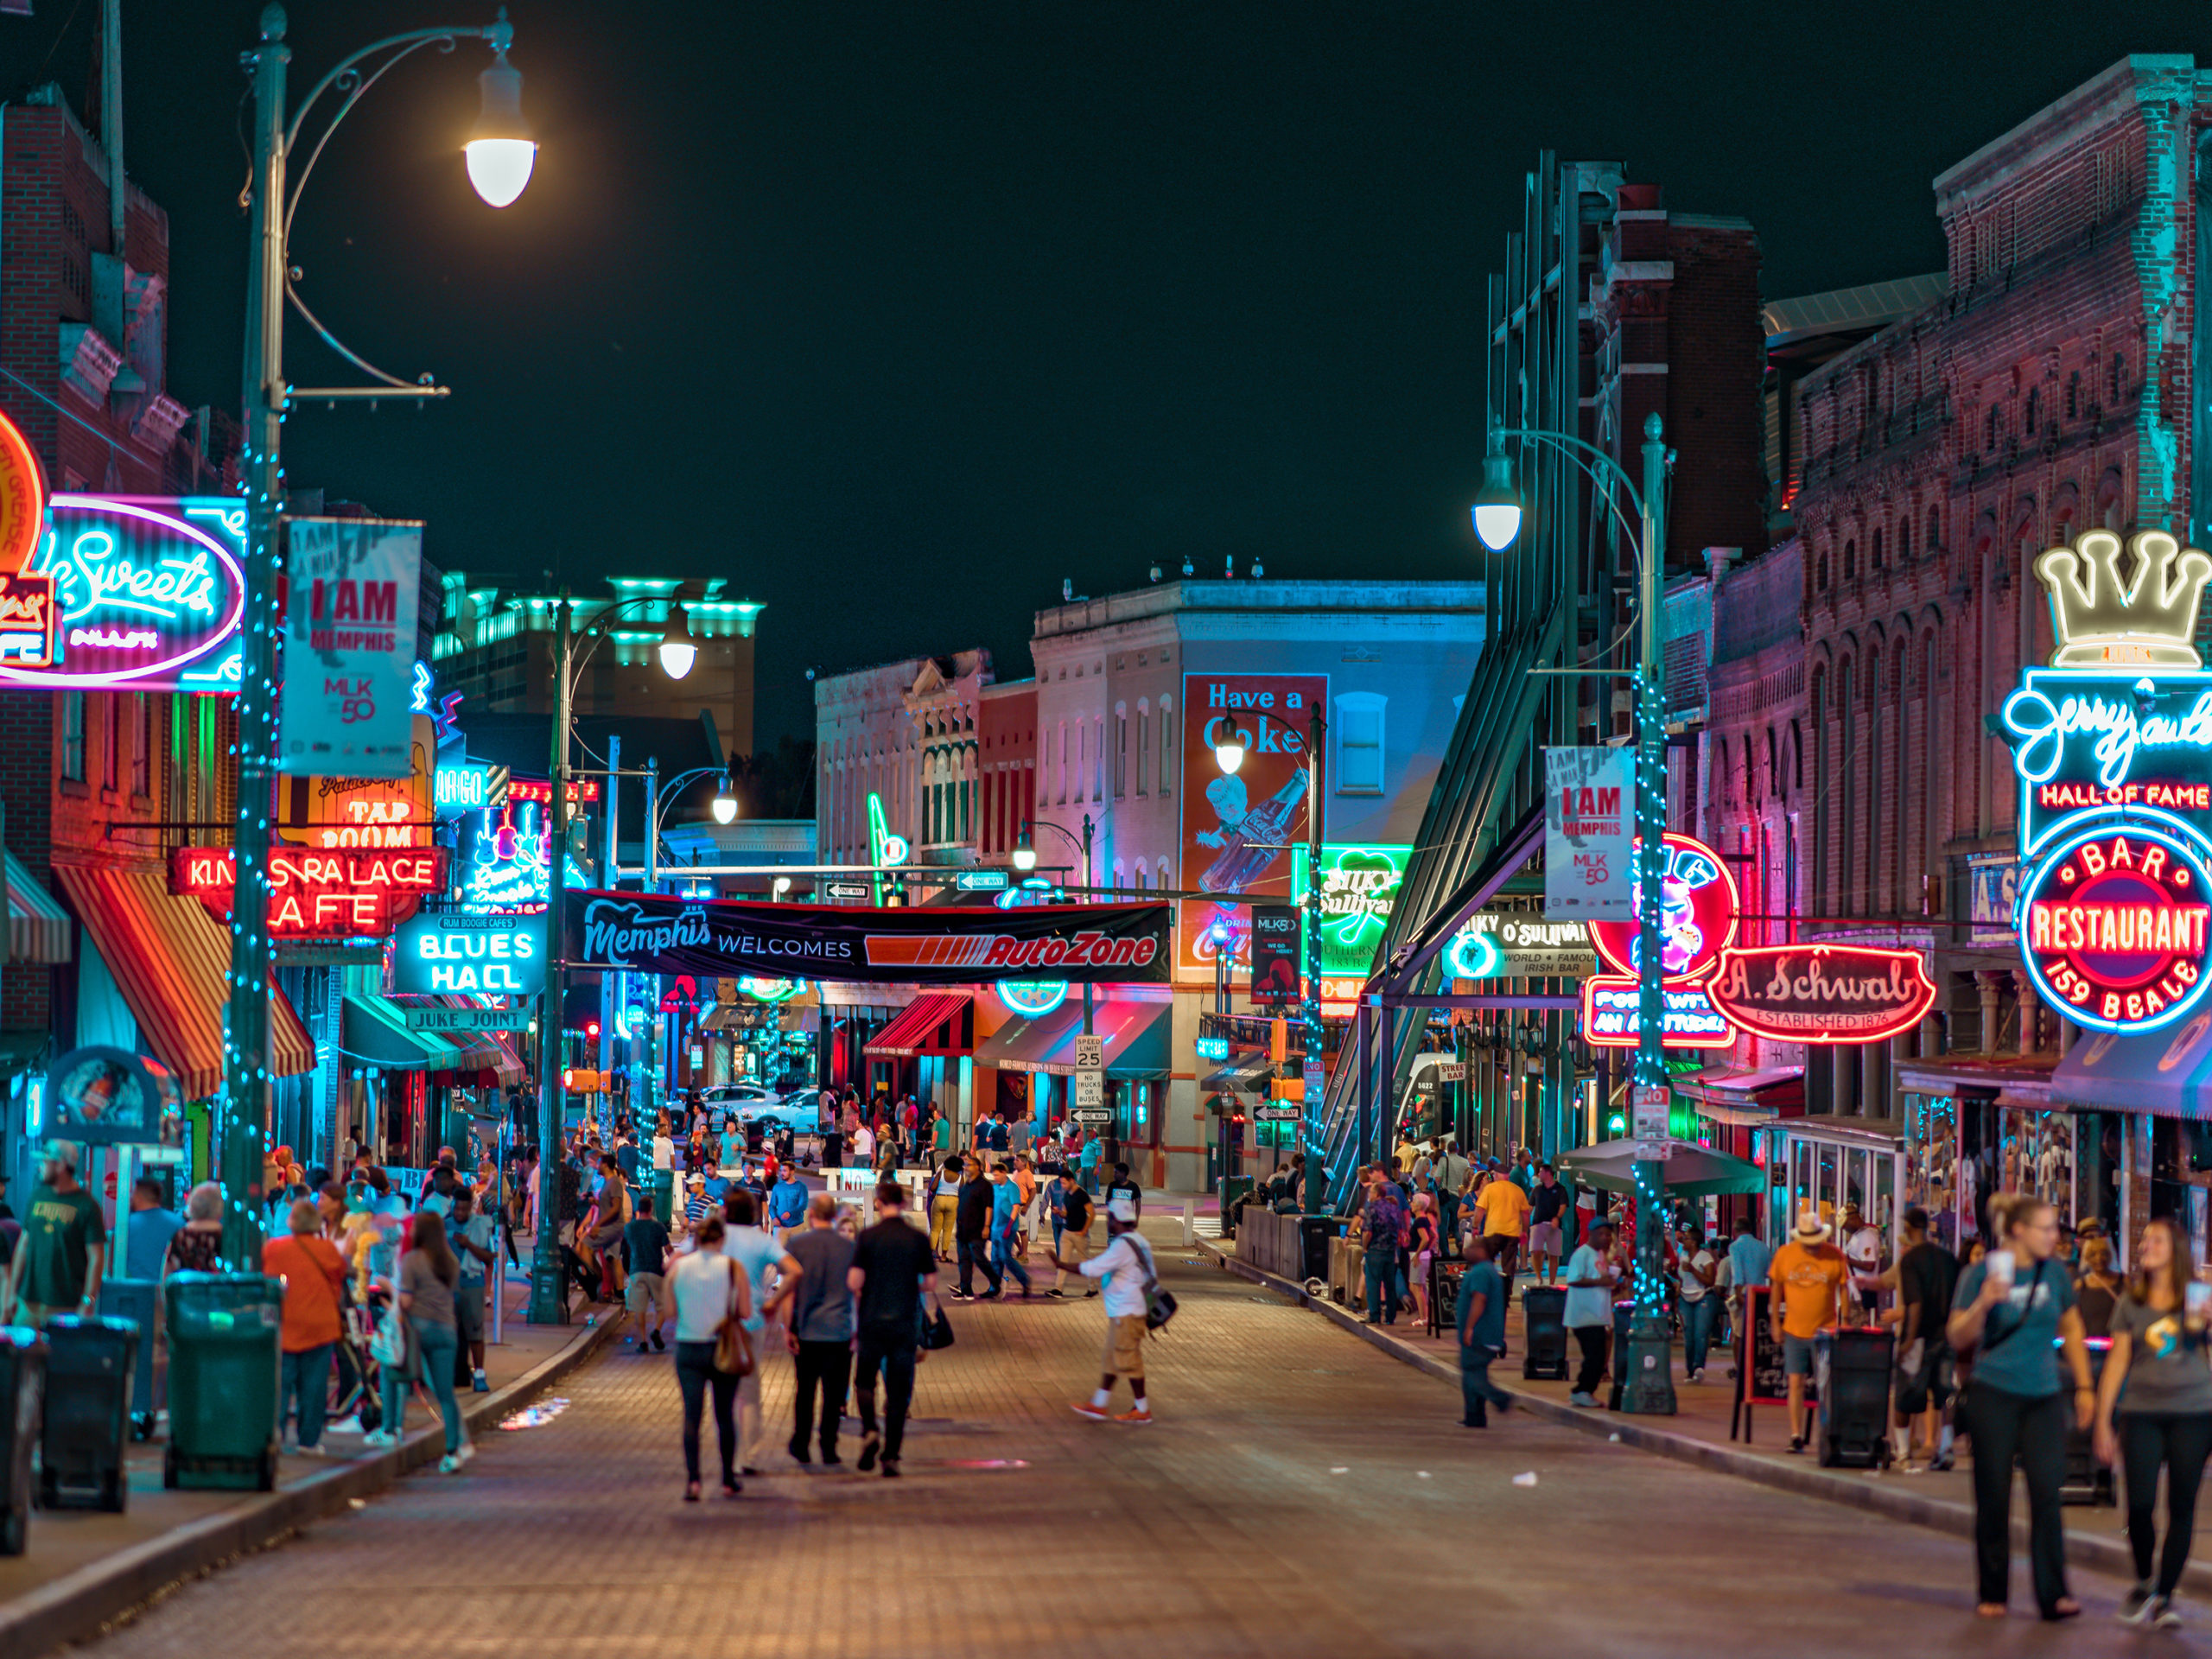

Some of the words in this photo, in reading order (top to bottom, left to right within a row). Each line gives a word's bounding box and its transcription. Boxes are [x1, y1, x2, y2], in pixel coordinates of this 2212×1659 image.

[9, 476, 26, 555] GREASE
[62, 531, 214, 620] Sweets
[312, 578, 324, 620] I
[334, 579, 398, 621] AM
[310, 629, 396, 652] MEMPHIS
[324, 677, 373, 697] MLK
[1210, 684, 1274, 709] Have
[1287, 692, 1302, 709] a
[340, 698, 376, 724] 50
[1204, 716, 1303, 753] Coke
[1557, 749, 1575, 768] AM
[435, 769, 482, 805] ARGO
[2041, 785, 2102, 807] HALL
[2107, 785, 2139, 806] OF
[2146, 785, 2210, 810] FAME
[348, 801, 410, 823] TAP
[1563, 787, 1571, 815] I
[1578, 787, 1621, 815] AM
[322, 826, 413, 849] ROOM
[1563, 822, 1621, 836] MEMPHIS
[1573, 854, 1607, 867] MLK
[2082, 836, 2166, 880] BAR
[191, 857, 289, 887] KINS
[303, 857, 433, 886] PALACE
[1586, 868, 1609, 886] 50
[267, 894, 378, 928] AFE
[443, 918, 460, 927] RUM
[461, 918, 487, 927] BOOGIE
[2035, 907, 2209, 951] RESTAURANT
[419, 934, 534, 959] BLUES
[583, 917, 711, 961] Memphis
[718, 934, 852, 958] WELCOMES
[982, 931, 1159, 968] AutoZone
[1321, 944, 1376, 956] UTHERN
[1332, 958, 1348, 967] 183
[1525, 963, 1554, 972] IRISH
[1559, 963, 1580, 972] BAR
[432, 964, 521, 990] HALL
[1766, 956, 1923, 1001] Schwab
[1595, 992, 1640, 1009] POR
[1666, 993, 1710, 1009] WIT
[2045, 960, 2091, 1003] 159
[2102, 960, 2199, 1020] BEALE
[416, 1013, 459, 1027] JUKE
[470, 1012, 520, 1027] JOINT
[1757, 1010, 1857, 1029] ESTABLISHED
[1862, 1014, 1889, 1027] 1876
[1078, 1053, 1100, 1065] 25
[1643, 1090, 1662, 1102] NO
